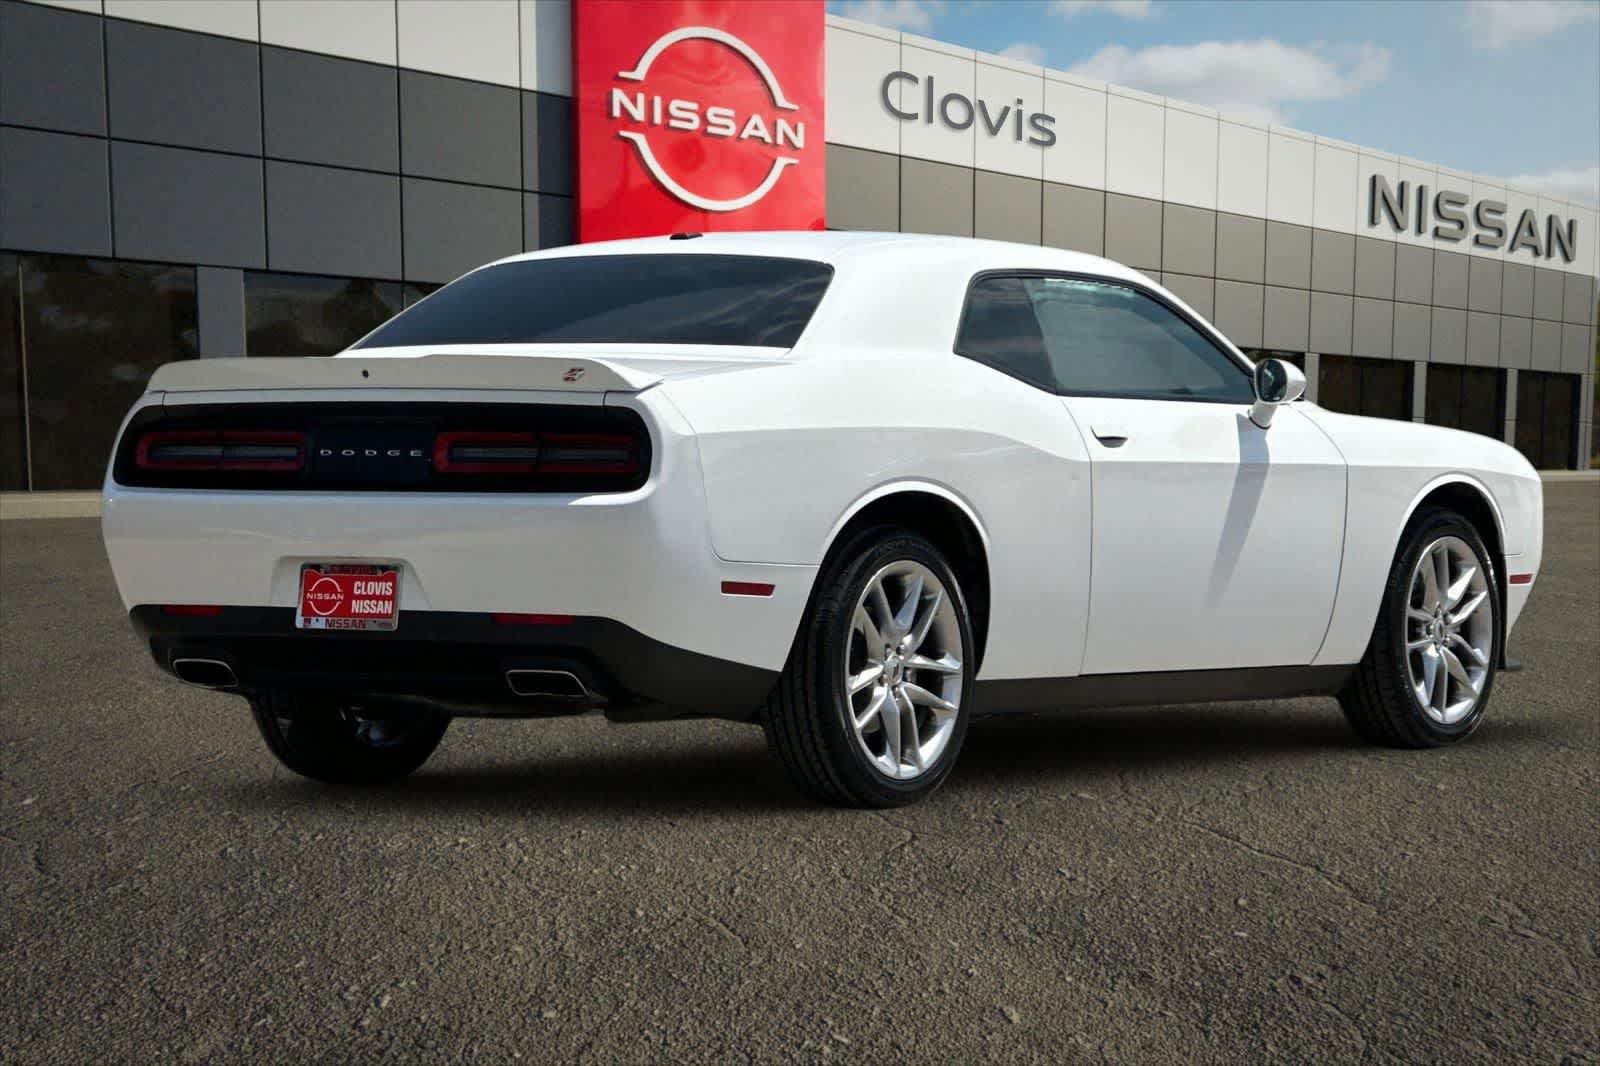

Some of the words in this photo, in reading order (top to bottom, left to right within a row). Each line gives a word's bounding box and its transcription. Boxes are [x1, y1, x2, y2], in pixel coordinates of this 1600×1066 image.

[611, 88, 805, 149] NISSAN
[881, 71, 1057, 147] Clovis
[1368, 174, 1578, 263] NISSAN
[351, 600, 393, 614] NISSAN
[354, 581, 393, 596] CLOVIS
[324, 619, 368, 629] NISSAN
